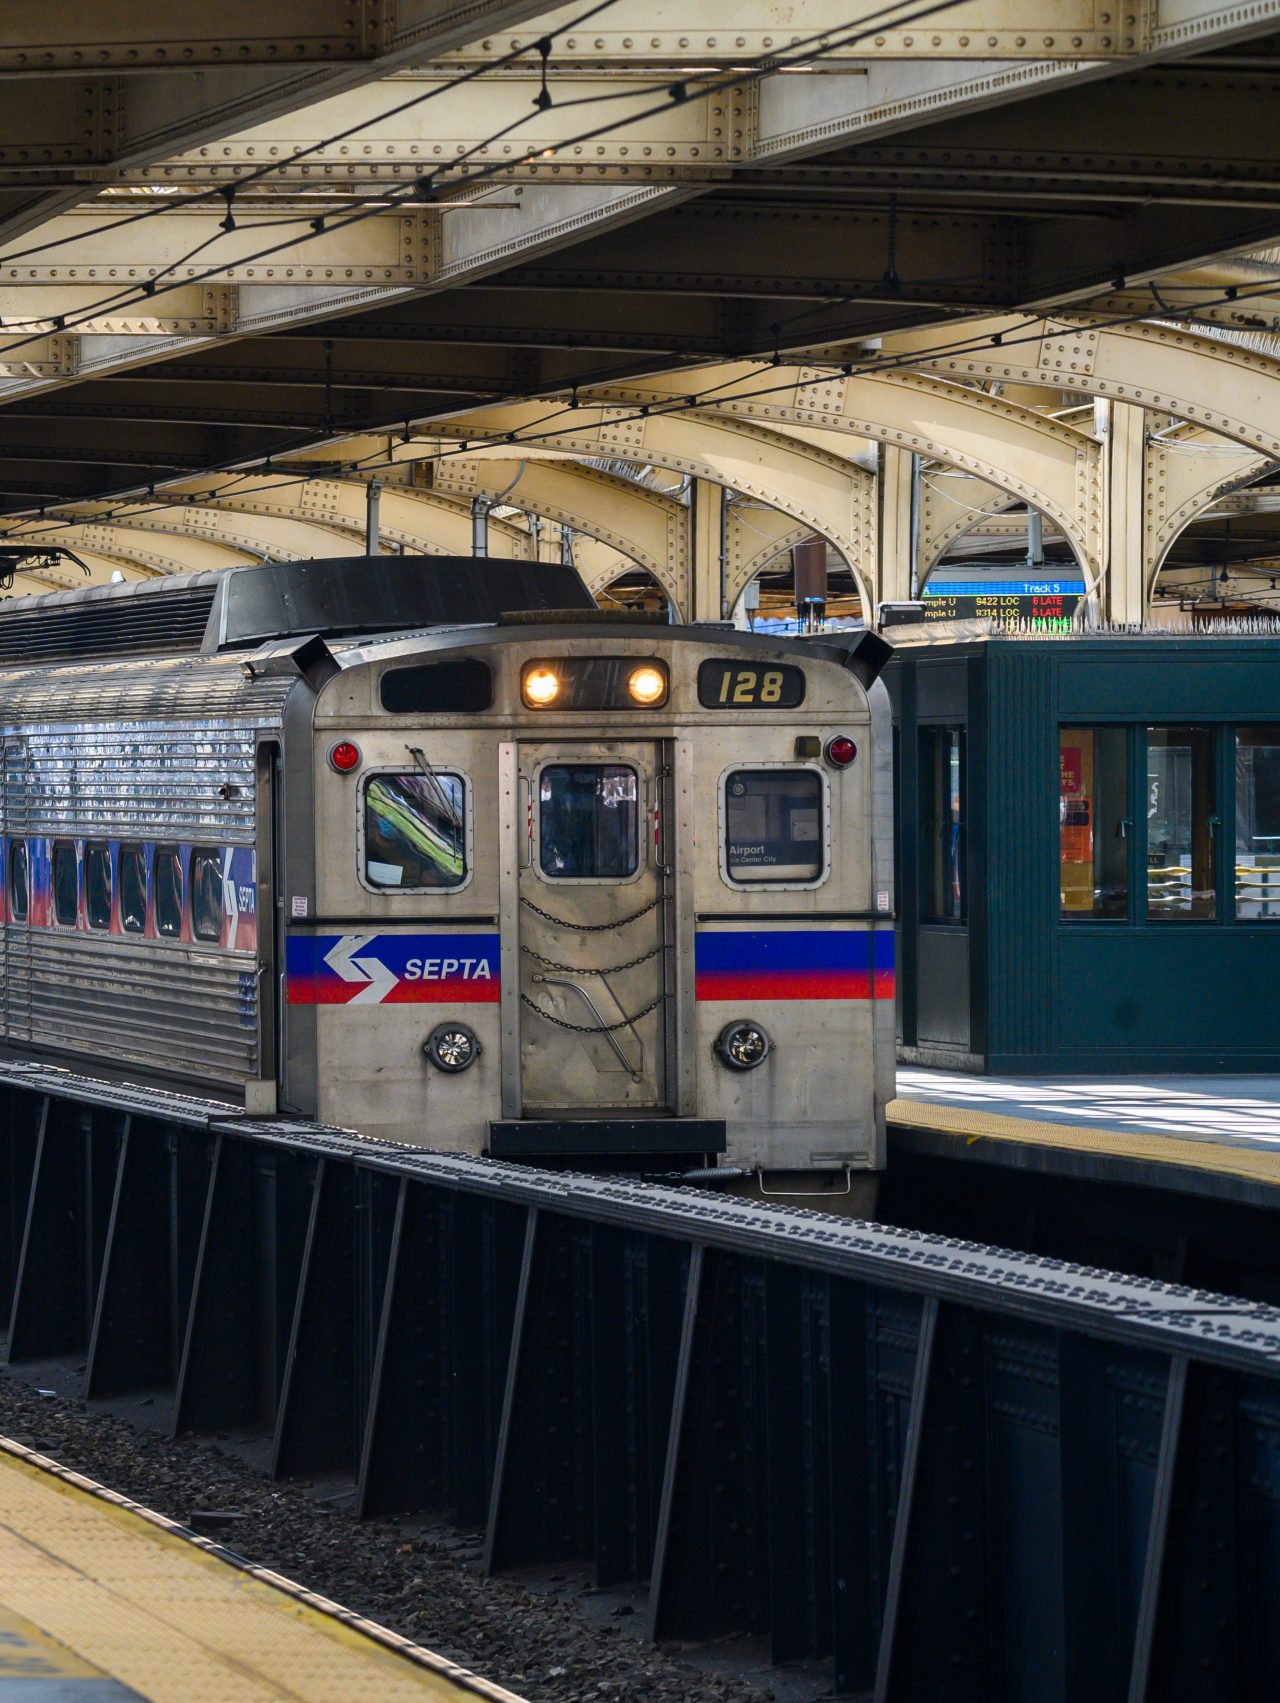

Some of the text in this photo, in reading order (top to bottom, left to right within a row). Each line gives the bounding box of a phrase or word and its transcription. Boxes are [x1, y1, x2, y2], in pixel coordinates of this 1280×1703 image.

[1023, 584, 1060, 593] Track 5
[976, 597, 1020, 606] 9422 LOC
[1032, 596, 1063, 605] 6 LATE
[1000, 608, 1020, 617] LOC
[1032, 608, 1062, 617] 5 LATE
[719, 671, 784, 702] 128
[729, 845, 765, 856] Airport
[763, 856, 777, 864] City
[239, 885, 255, 914] SEPTA
[404, 959, 491, 980] SEPTA
